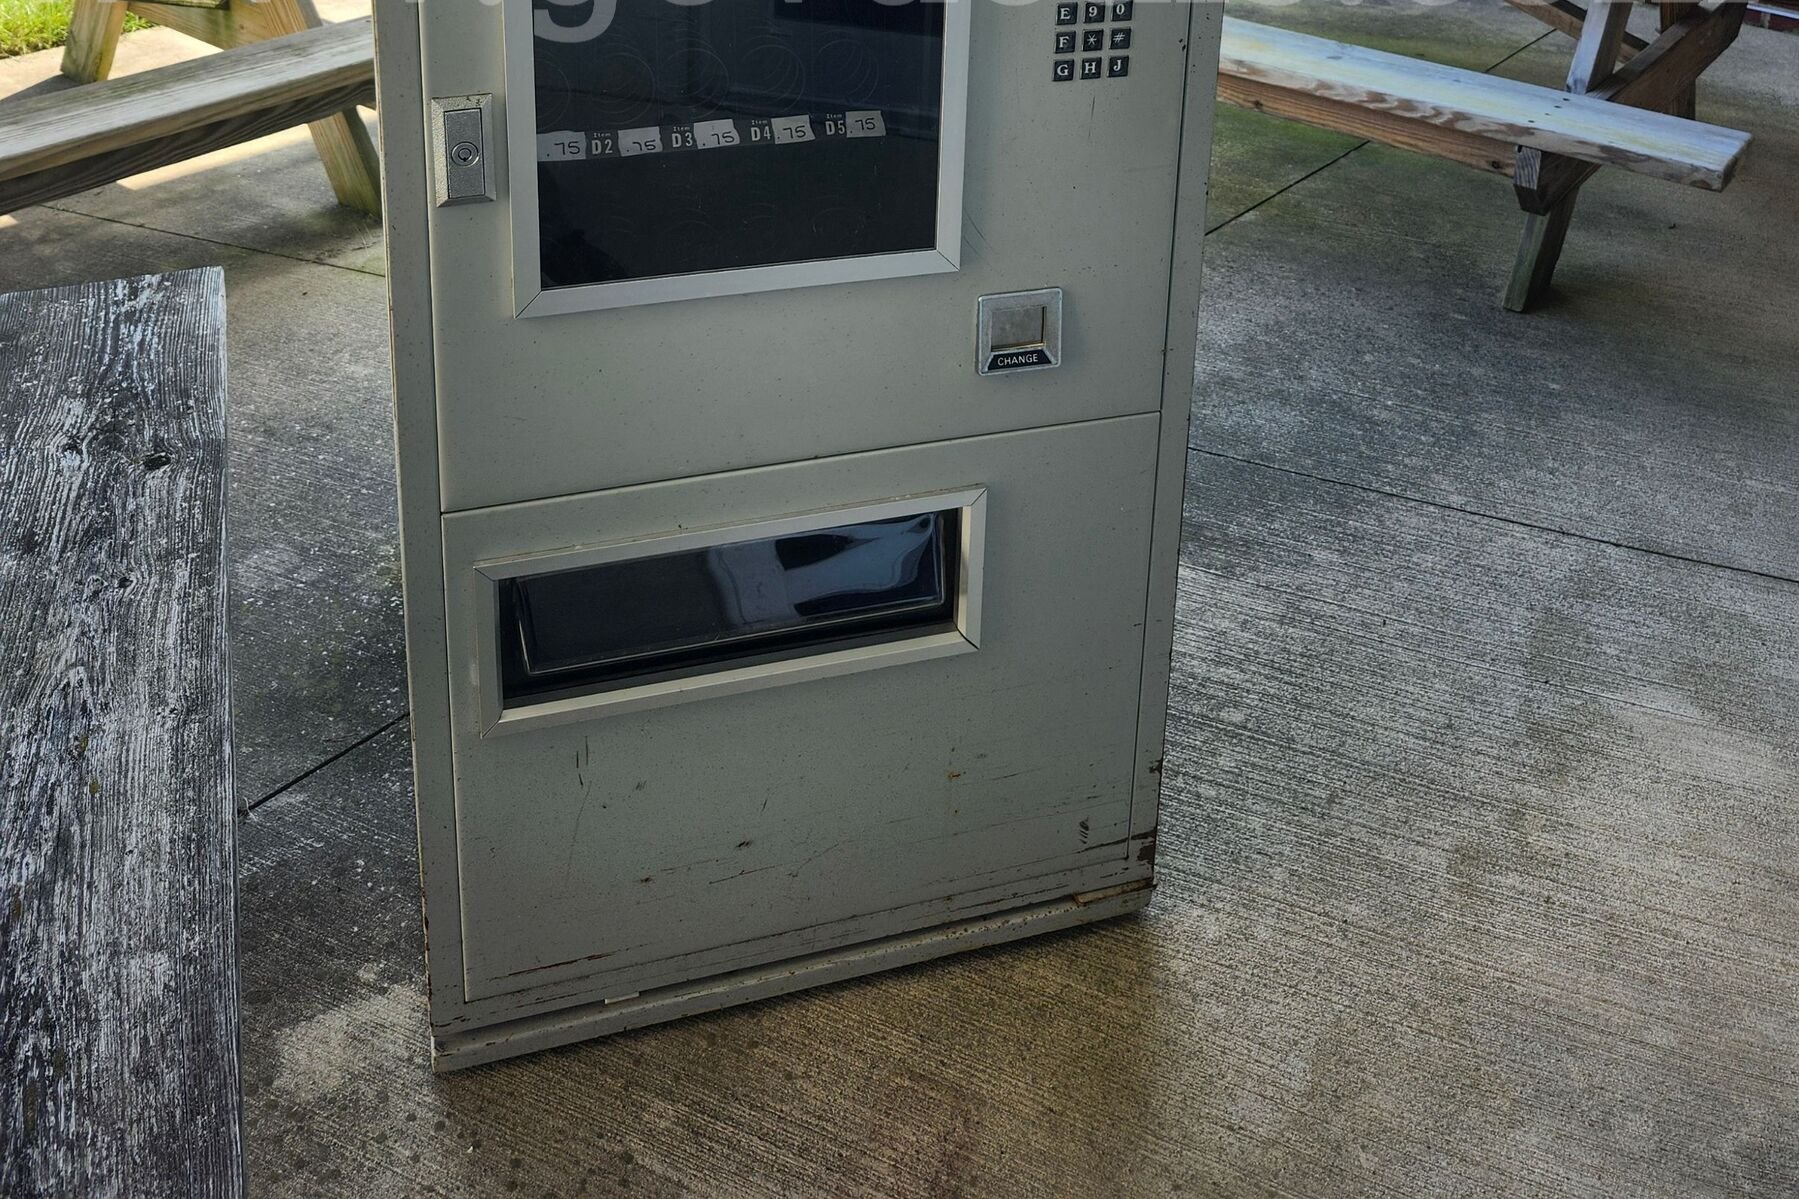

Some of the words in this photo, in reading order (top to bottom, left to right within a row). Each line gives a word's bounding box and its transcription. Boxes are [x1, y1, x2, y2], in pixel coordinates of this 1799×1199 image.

[1060, 8, 1072, 20] E
[1088, 6, 1098, 17] 9
[1116, 4, 1124, 15] 0
[1058, 36, 1070, 48] F
[1113, 32, 1125, 43] #
[1056, 64, 1069, 76] G
[1084, 62, 1096, 74] H
[1113, 60, 1122, 72] J
[825, 120, 846, 136] D5
[850, 117, 876, 134] .75
[702, 130, 735, 147] .75
[750, 126, 772, 142] D4
[776, 125, 806, 140] .75
[592, 139, 614, 154] D2
[626, 139, 656, 152] .75
[672, 132, 694, 148] D3
[547, 140, 580, 157] .75
[997, 353, 1038, 366] CHANGE
